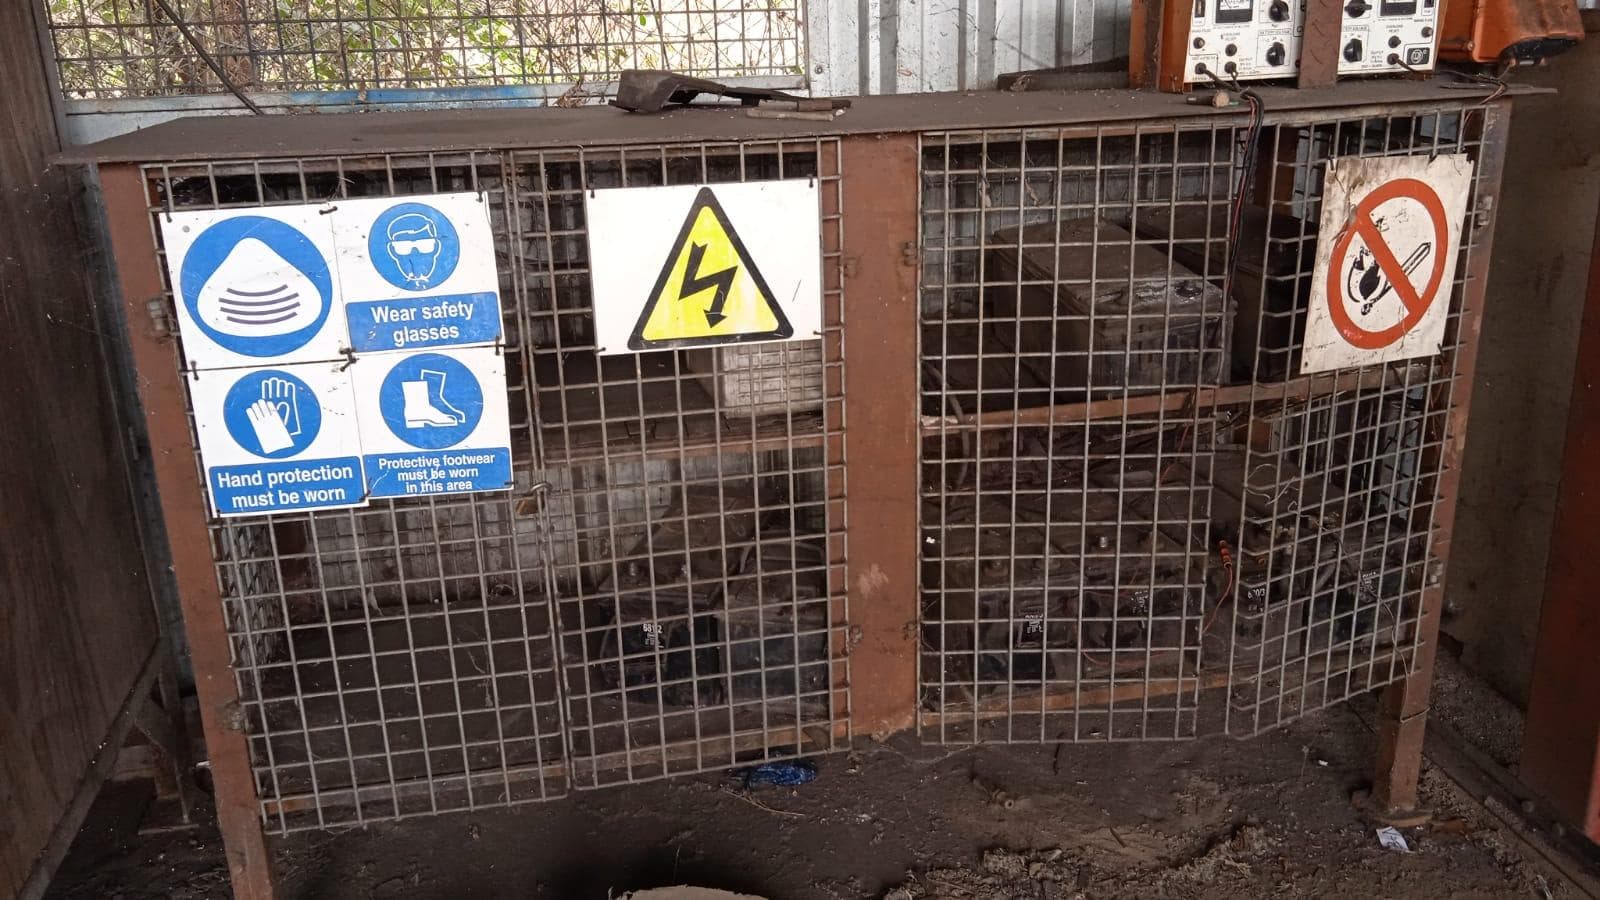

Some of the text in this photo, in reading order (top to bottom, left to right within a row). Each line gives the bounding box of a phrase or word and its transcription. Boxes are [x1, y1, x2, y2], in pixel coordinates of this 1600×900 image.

[370, 301, 474, 324] Wear safety
[393, 326, 460, 347] glasses
[378, 454, 496, 470] Protective footwear
[217, 465, 353, 488] Hand protection
[397, 468, 479, 481] must be worn
[406, 480, 473, 493] in this area
[231, 488, 346, 508] must be worn
